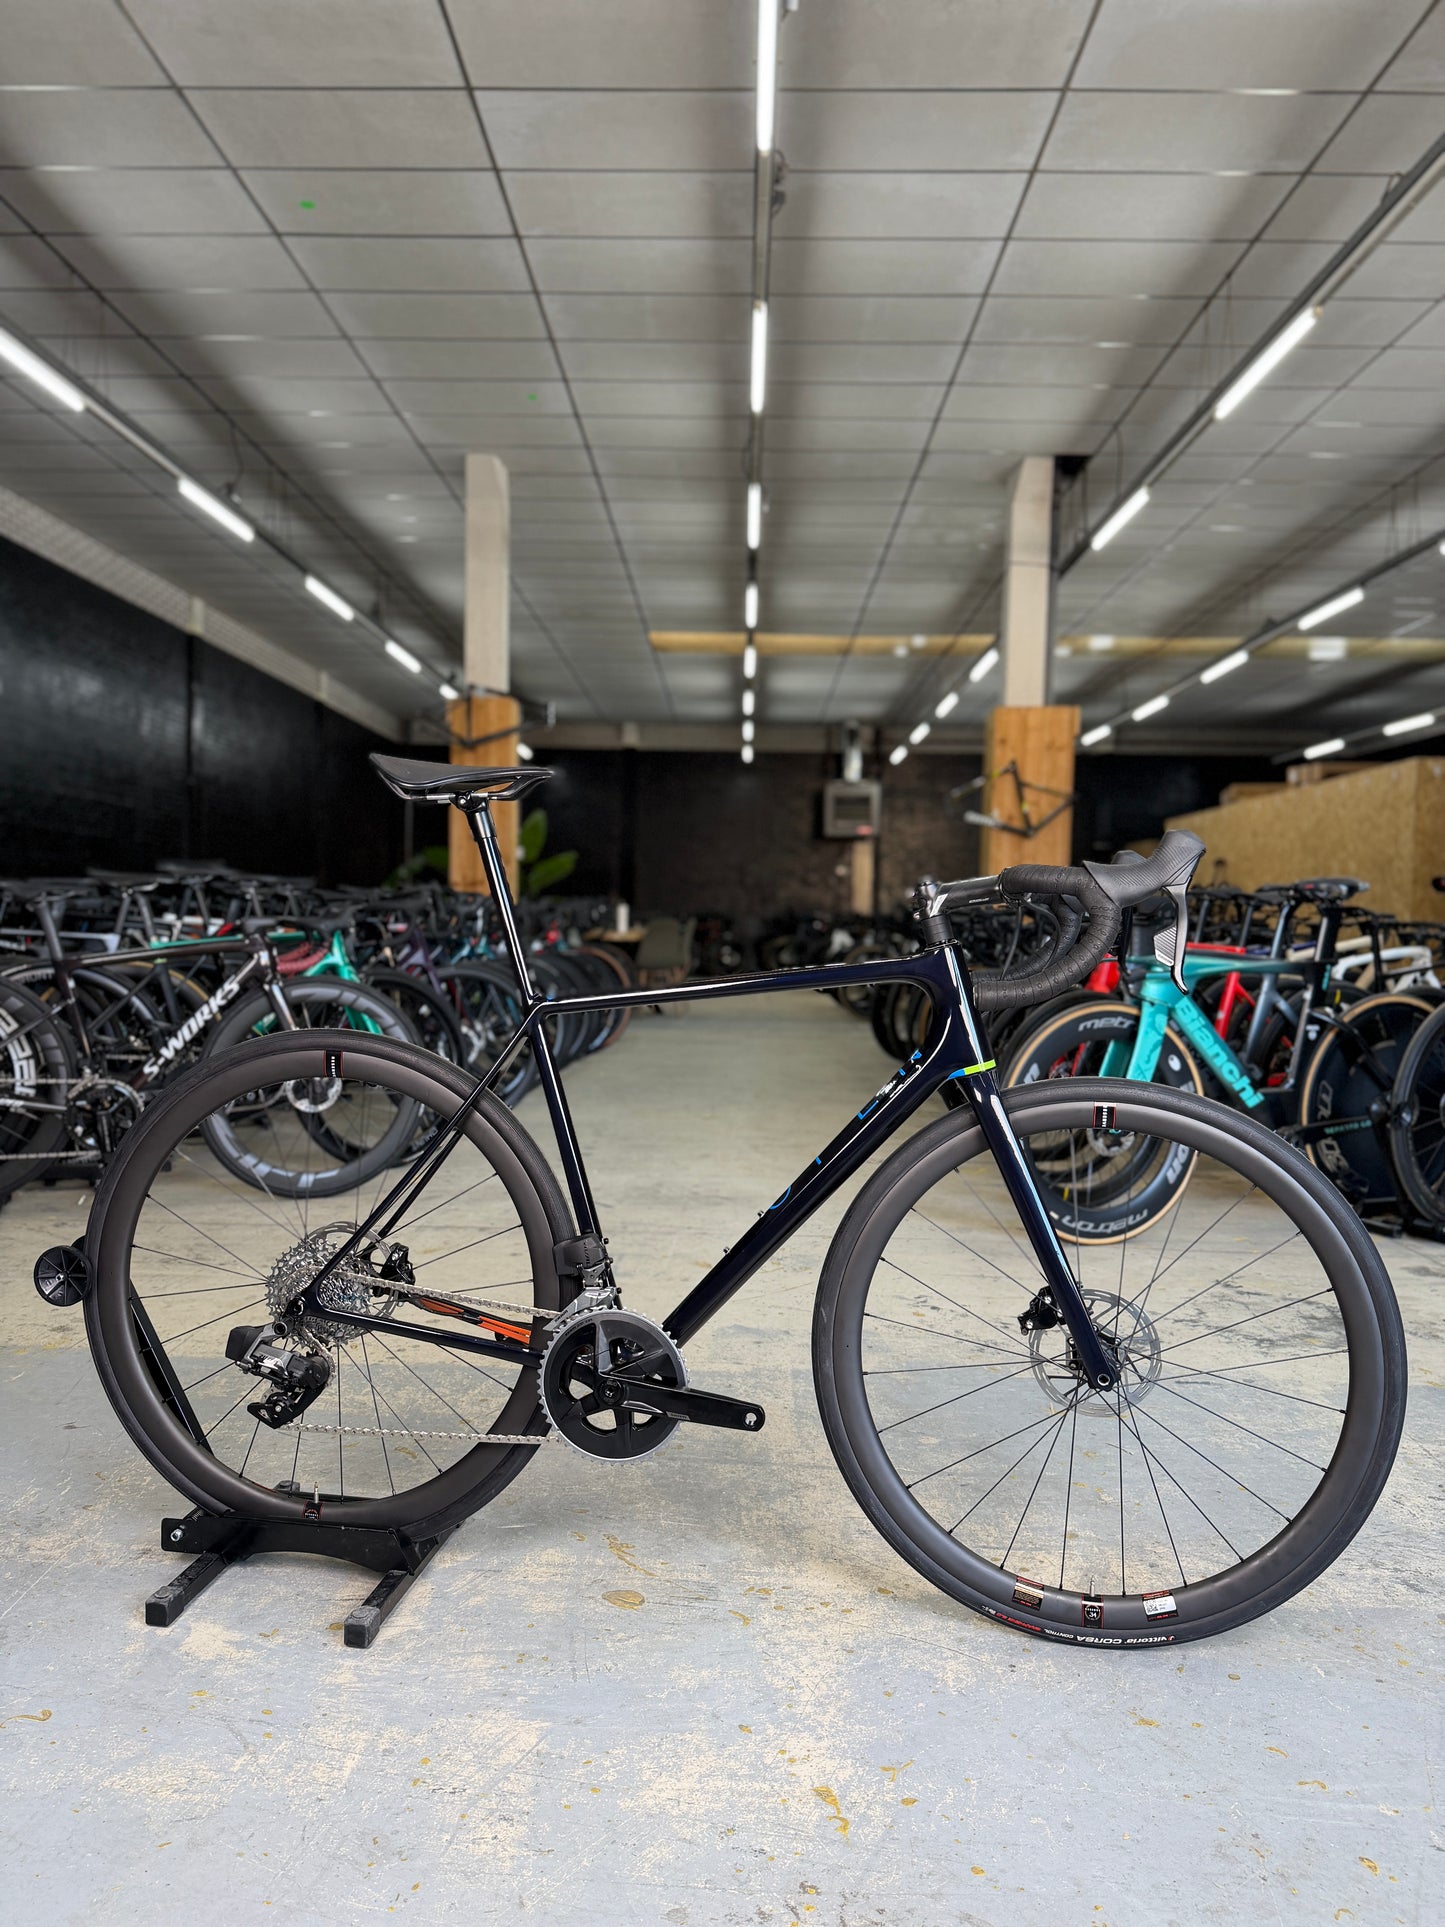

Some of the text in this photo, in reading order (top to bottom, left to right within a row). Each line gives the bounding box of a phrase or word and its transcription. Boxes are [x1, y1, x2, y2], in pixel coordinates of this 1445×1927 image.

[142, 974, 240, 1081] S-WORKS
[1077, 1015, 1137, 1032] metr
[1172, 999, 1266, 1109] Bianchi
[1061, 1208, 1149, 1234] metron
[1076, 1635, 1123, 1645] CORSA
[1125, 1635, 1168, 1644] vittoria
